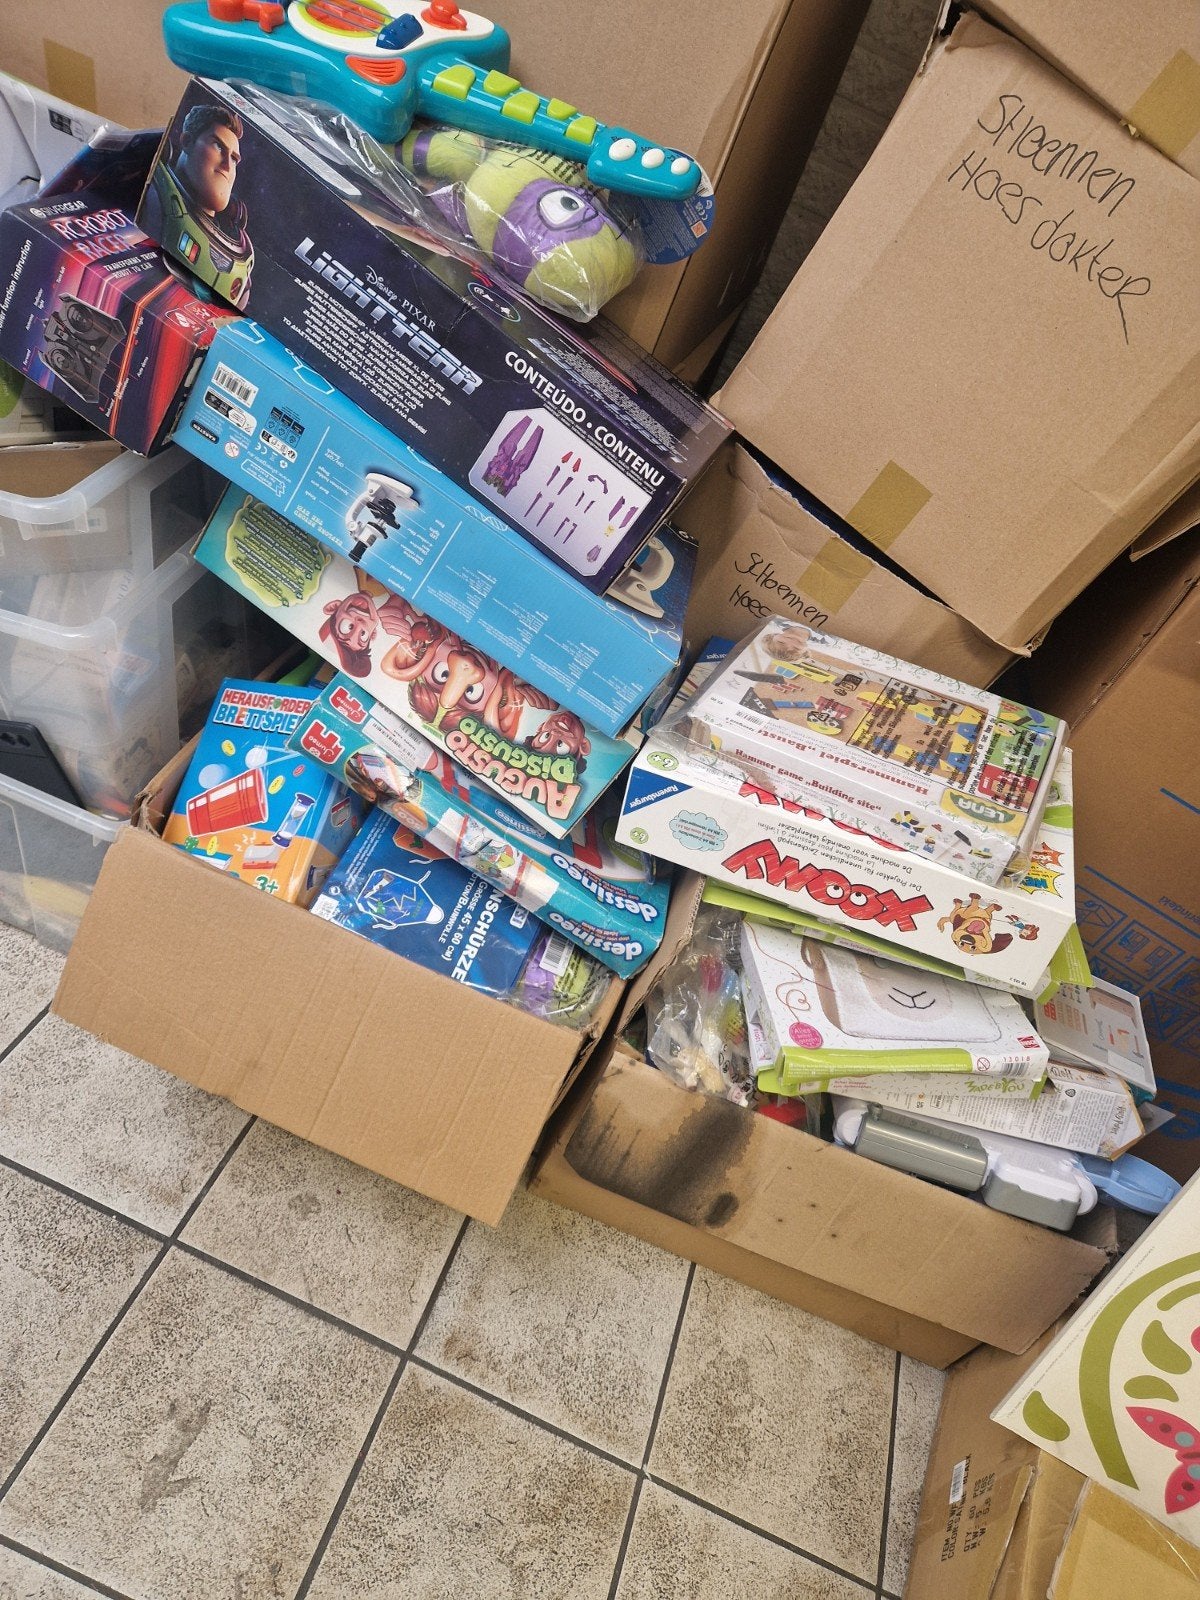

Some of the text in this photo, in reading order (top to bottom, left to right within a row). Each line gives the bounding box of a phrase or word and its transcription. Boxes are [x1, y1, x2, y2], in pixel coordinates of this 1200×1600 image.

[0, 238, 32, 311] function instruction
[361, 264, 437, 332] Disney PIXAR
[293, 236, 485, 397] LIGHTYEAR
[501, 350, 589, 424] CONTEÚDO
[591, 423, 665, 488] CONTENU
[192, 423, 216, 441] KARSTEN
[305, 734, 335, 758] Jumbo
[458, 716, 575, 785] DISGUSTO
[653, 754, 675, 769] 6+
[733, 747, 776, 771] Hammer
[776, 766, 803, 782] game
[818, 749, 929, 795] Hammerspiel
[445, 730, 580, 818] AUGUSTO
[629, 785, 677, 808] Ravensburger
[956, 797, 1005, 821] LENA
[633, 831, 645, 839] 6+
[775, 819, 912, 874] De machine voor oneindig tekenplezier
[785, 831, 816, 847] dessiner
[816, 841, 834, 853] pour
[818, 850, 862, 871] unendlichen
[833, 848, 863, 865] machine
[863, 859, 874, 868] La
[862, 866, 874, 876] für
[874, 870, 908, 888] Projektor
[253, 874, 280, 894] 3+
[552, 855, 656, 922] dessineo
[721, 839, 933, 931] XOOMY
[907, 882, 922, 892] Der
[460, 911, 472, 923] 45
[450, 931, 462, 944] 60
[549, 912, 640, 959] dessineo
[961, 1452, 972, 1484] BLACK
[962, 1530, 972, 1552] QTY
[972, 1477, 981, 1499] PCS
